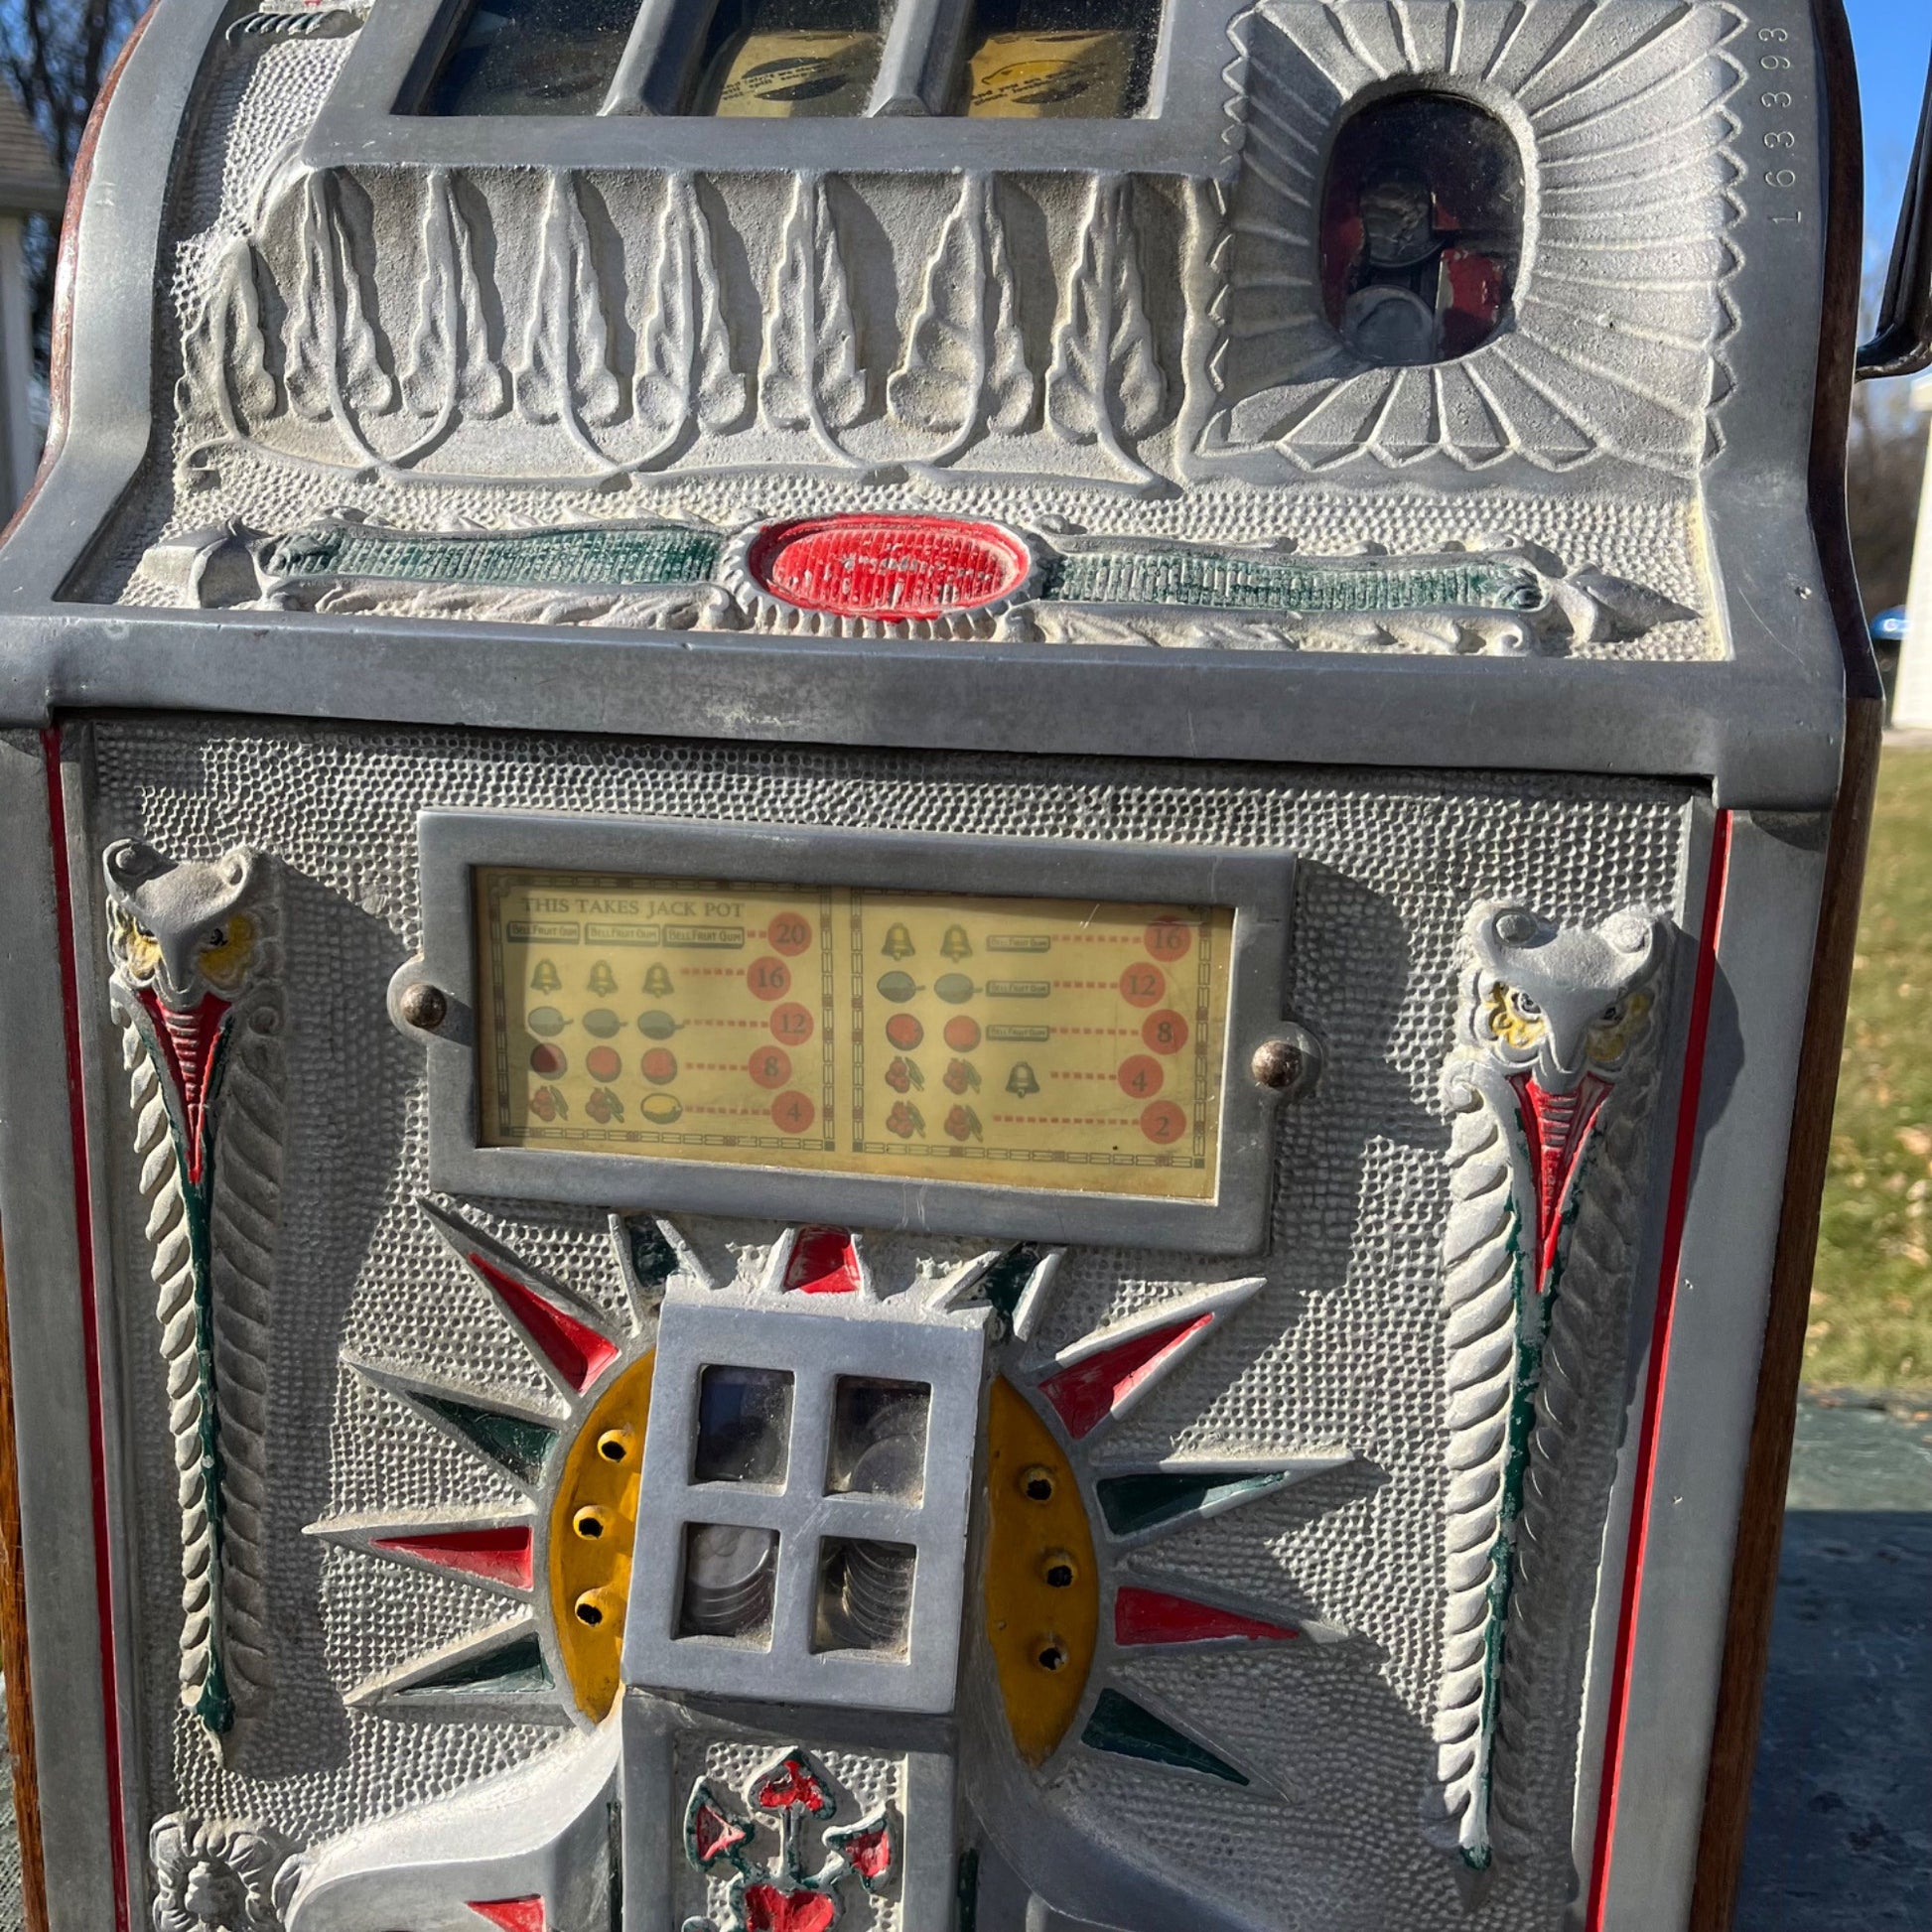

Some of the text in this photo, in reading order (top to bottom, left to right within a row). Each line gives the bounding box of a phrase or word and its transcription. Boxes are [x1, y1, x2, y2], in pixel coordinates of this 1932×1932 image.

[1757, 27, 1802, 224] 163393
[521, 897, 746, 919] THIS TAKES JACK POT
[775, 922, 806, 944] 20
[1152, 926, 1181, 949] 16
[757, 966, 785, 988] 16
[1128, 974, 1157, 997] 12
[779, 1014, 807, 1035] 12
[1157, 1020, 1173, 1043] 8
[763, 1055, 779, 1077] 8
[1131, 1069, 1148, 1092] 4
[786, 1102, 802, 1123] 4
[1156, 1116, 1170, 1137] 2
